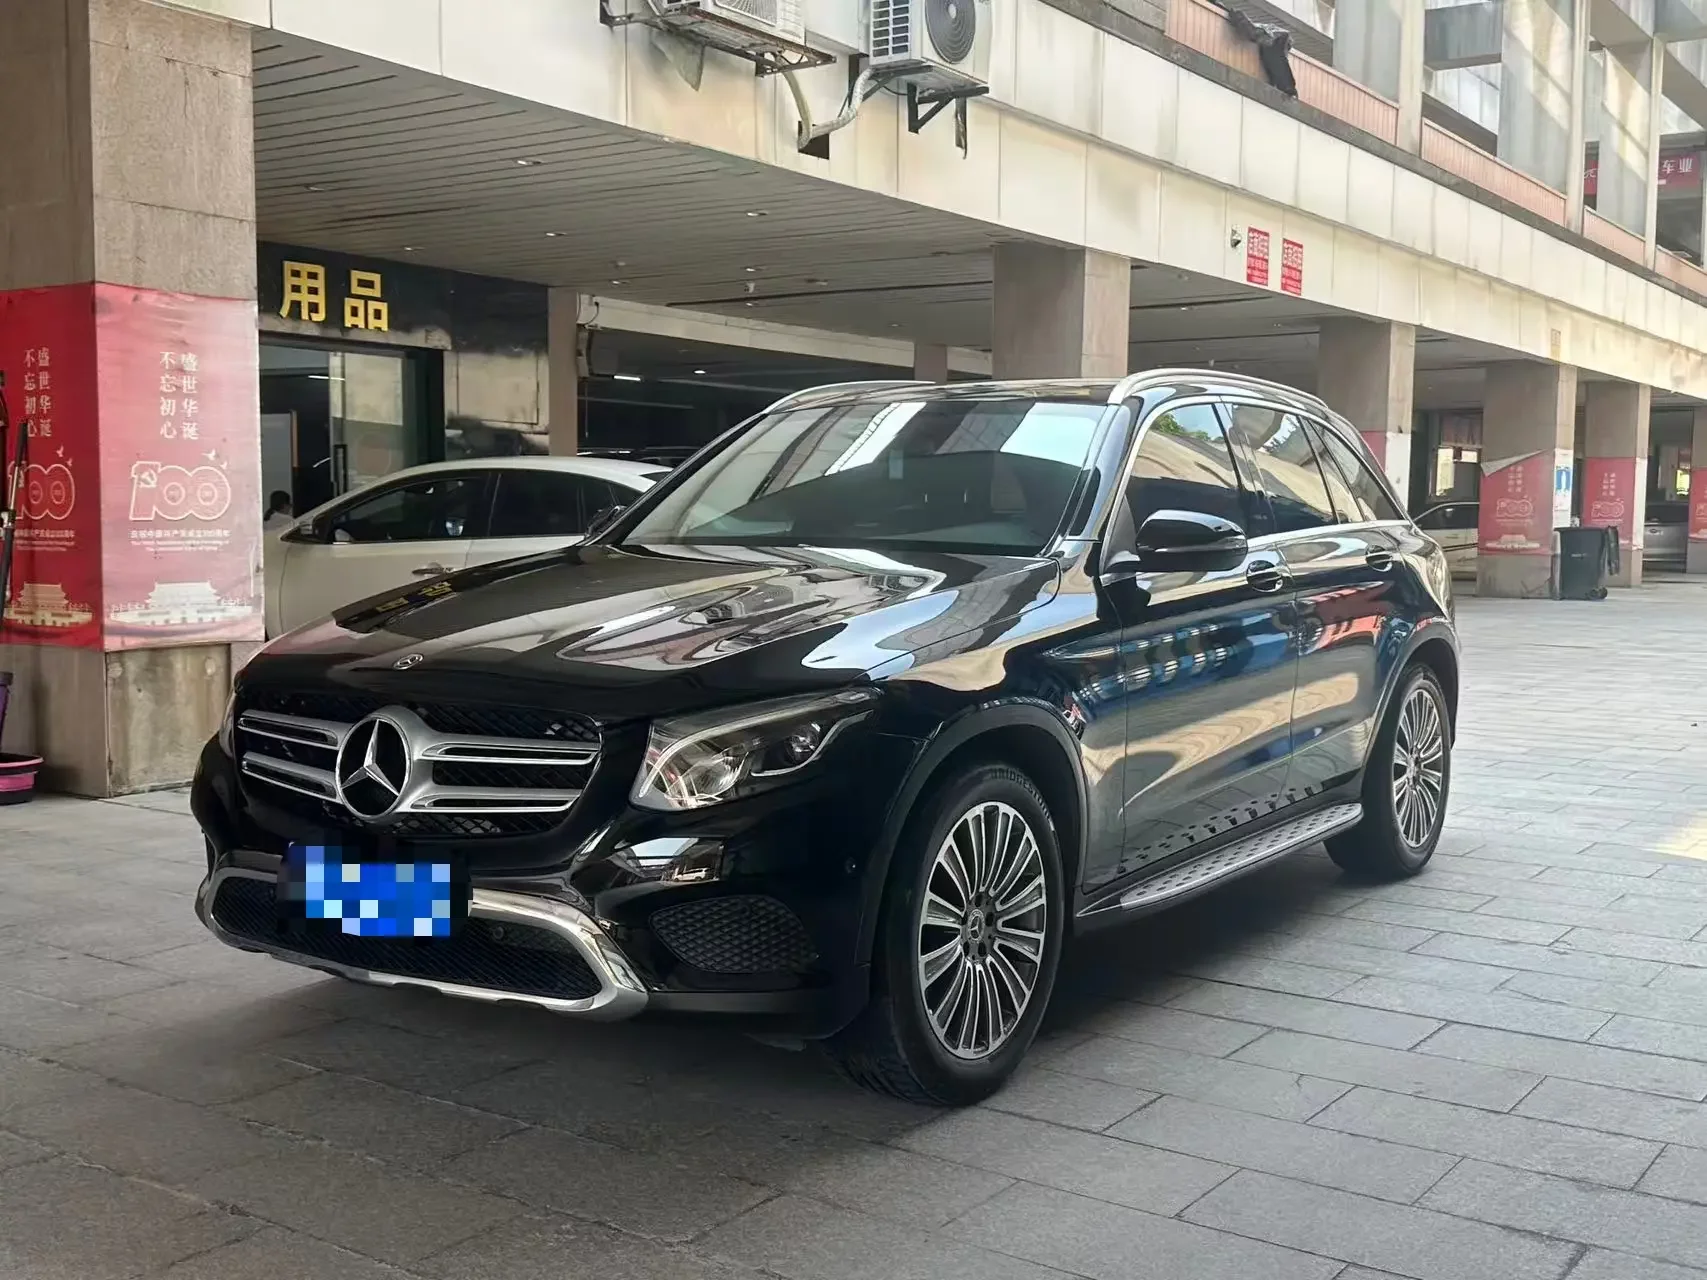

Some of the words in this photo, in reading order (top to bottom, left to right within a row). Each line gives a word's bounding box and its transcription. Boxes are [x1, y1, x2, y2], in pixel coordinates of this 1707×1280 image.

[279, 260, 389, 332] 用品
[24, 348, 37, 438] 不忘初心
[38, 347, 52, 437] 盛世华诞
[159, 351, 178, 439] 不忘初心
[180, 352, 200, 440] 盛世华诞
